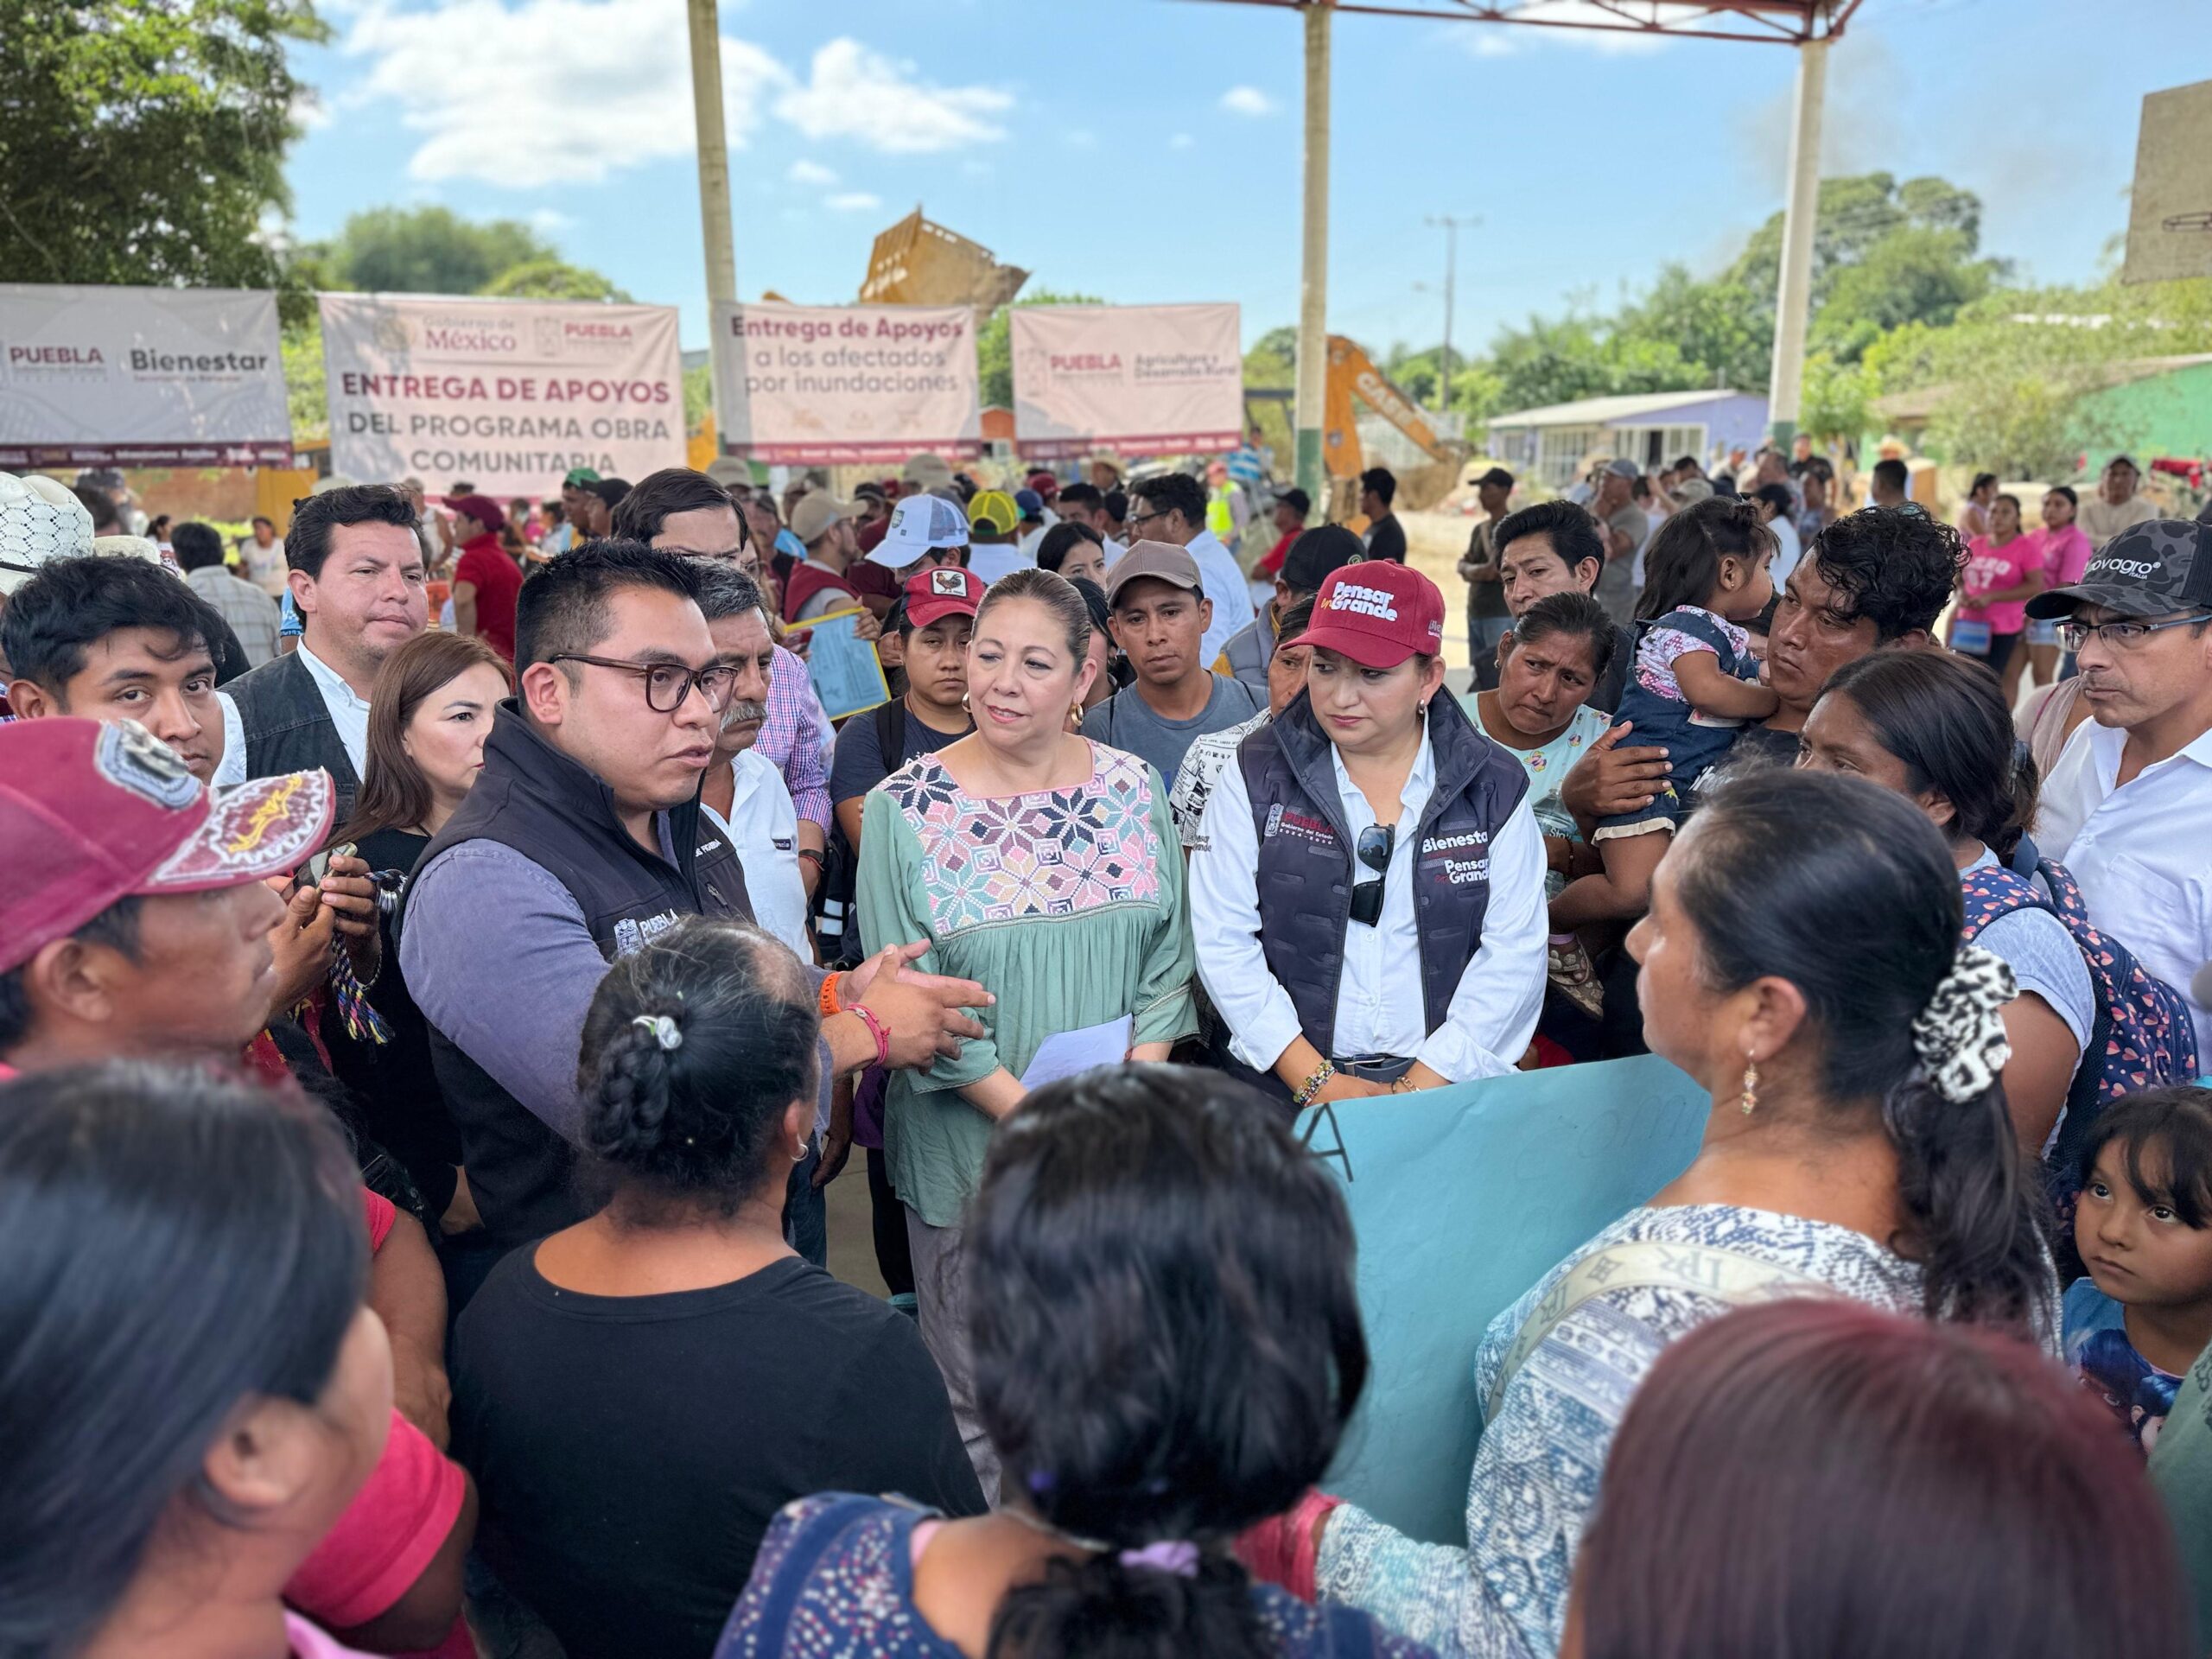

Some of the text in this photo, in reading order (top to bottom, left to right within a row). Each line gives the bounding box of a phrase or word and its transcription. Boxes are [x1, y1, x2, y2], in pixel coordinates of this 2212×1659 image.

[426, 328, 517, 351] México
[565, 322, 632, 337] PUEBLA
[731, 316, 963, 343] Entrega de Apoyos
[10, 347, 105, 364] PUEBLA
[130, 349, 268, 372] Bienestar
[755, 346, 947, 367] a los afectados
[1050, 353, 1122, 370] PUEBLA
[342, 372, 671, 404] ENTREGA DE APOYOS
[745, 371, 958, 397] por inundaciones
[348, 411, 671, 440] DEL PROGRAMA OBRA
[411, 449, 615, 474] COMUNITARIA
[1332, 581, 1395, 604] Pensar
[1331, 593, 1398, 622] Grande
[1421, 830, 1489, 854] Bienesta
[1449, 866, 1490, 885] Grand
